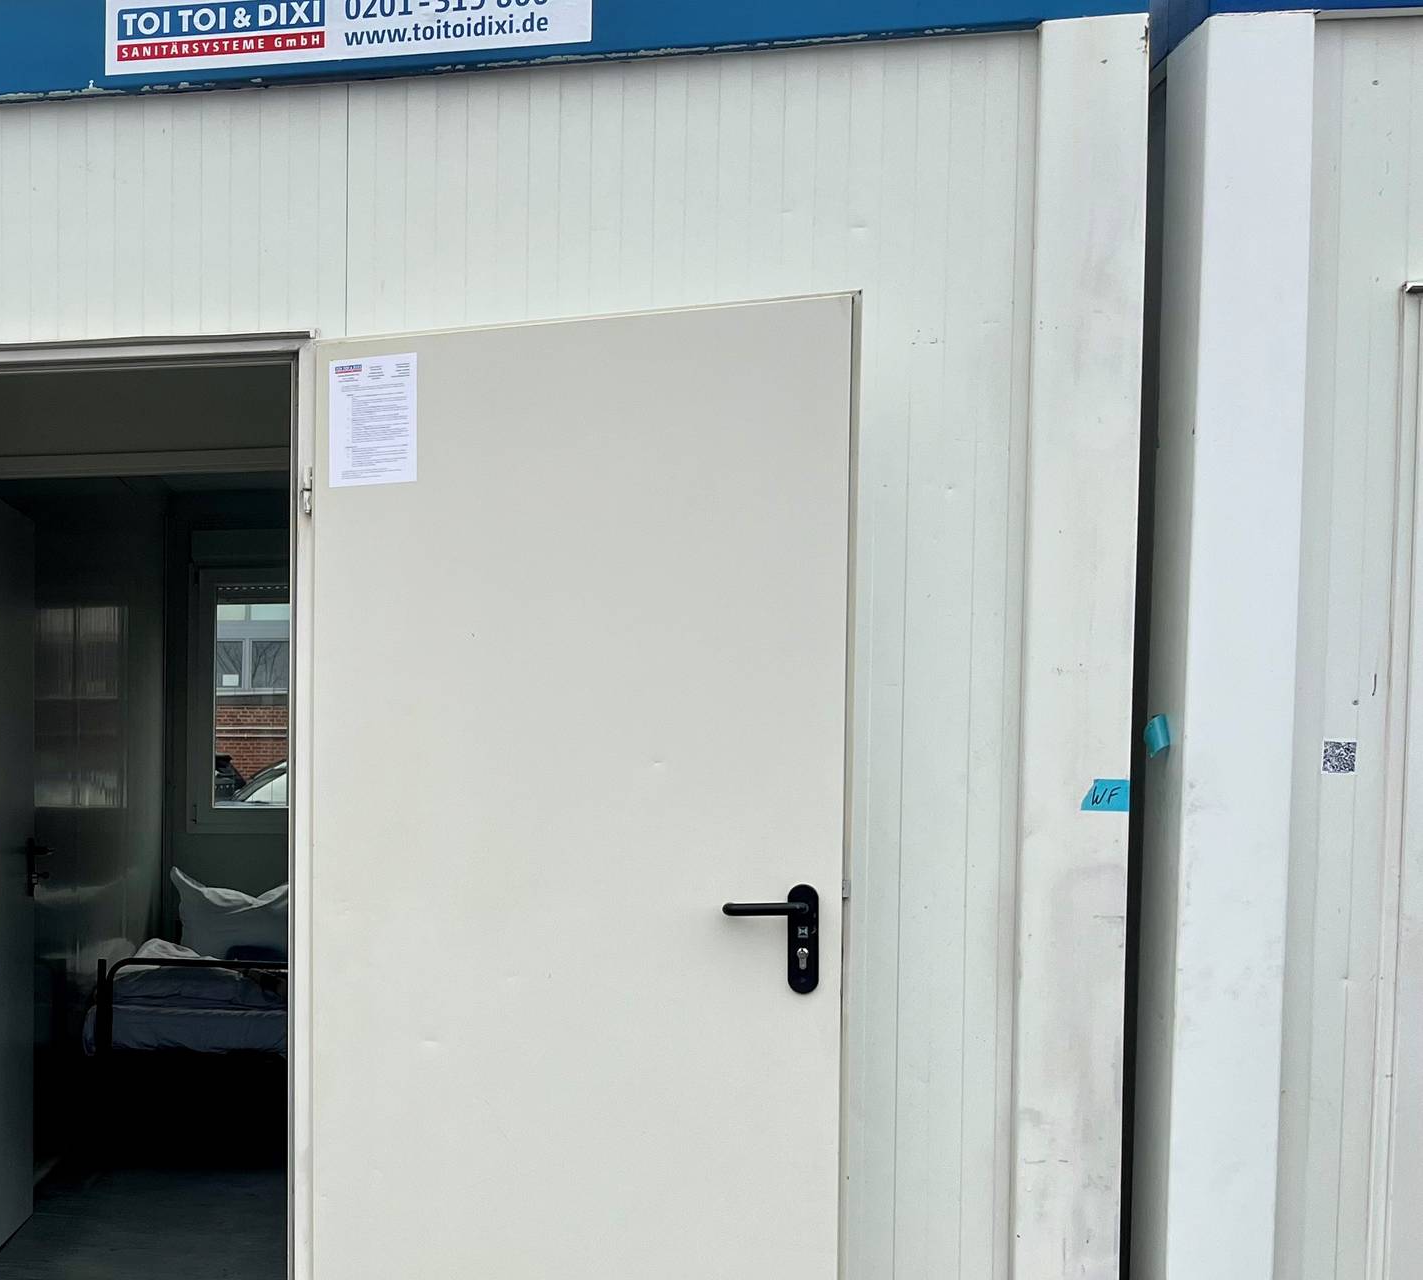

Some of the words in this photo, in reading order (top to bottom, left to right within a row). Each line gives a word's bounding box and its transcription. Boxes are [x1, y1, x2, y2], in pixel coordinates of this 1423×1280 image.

[122, 11, 170, 36] TOI
[178, 7, 226, 33] TOI
[233, 7, 251, 28] &
[258, 0, 320, 27] DIXI
[344, 12, 549, 46] www.toitoidixi.de
[122, 36, 265, 59] SANITÄRSYSTEME
[274, 34, 320, 48] GmbH
[1091, 786, 1122, 806] WF
